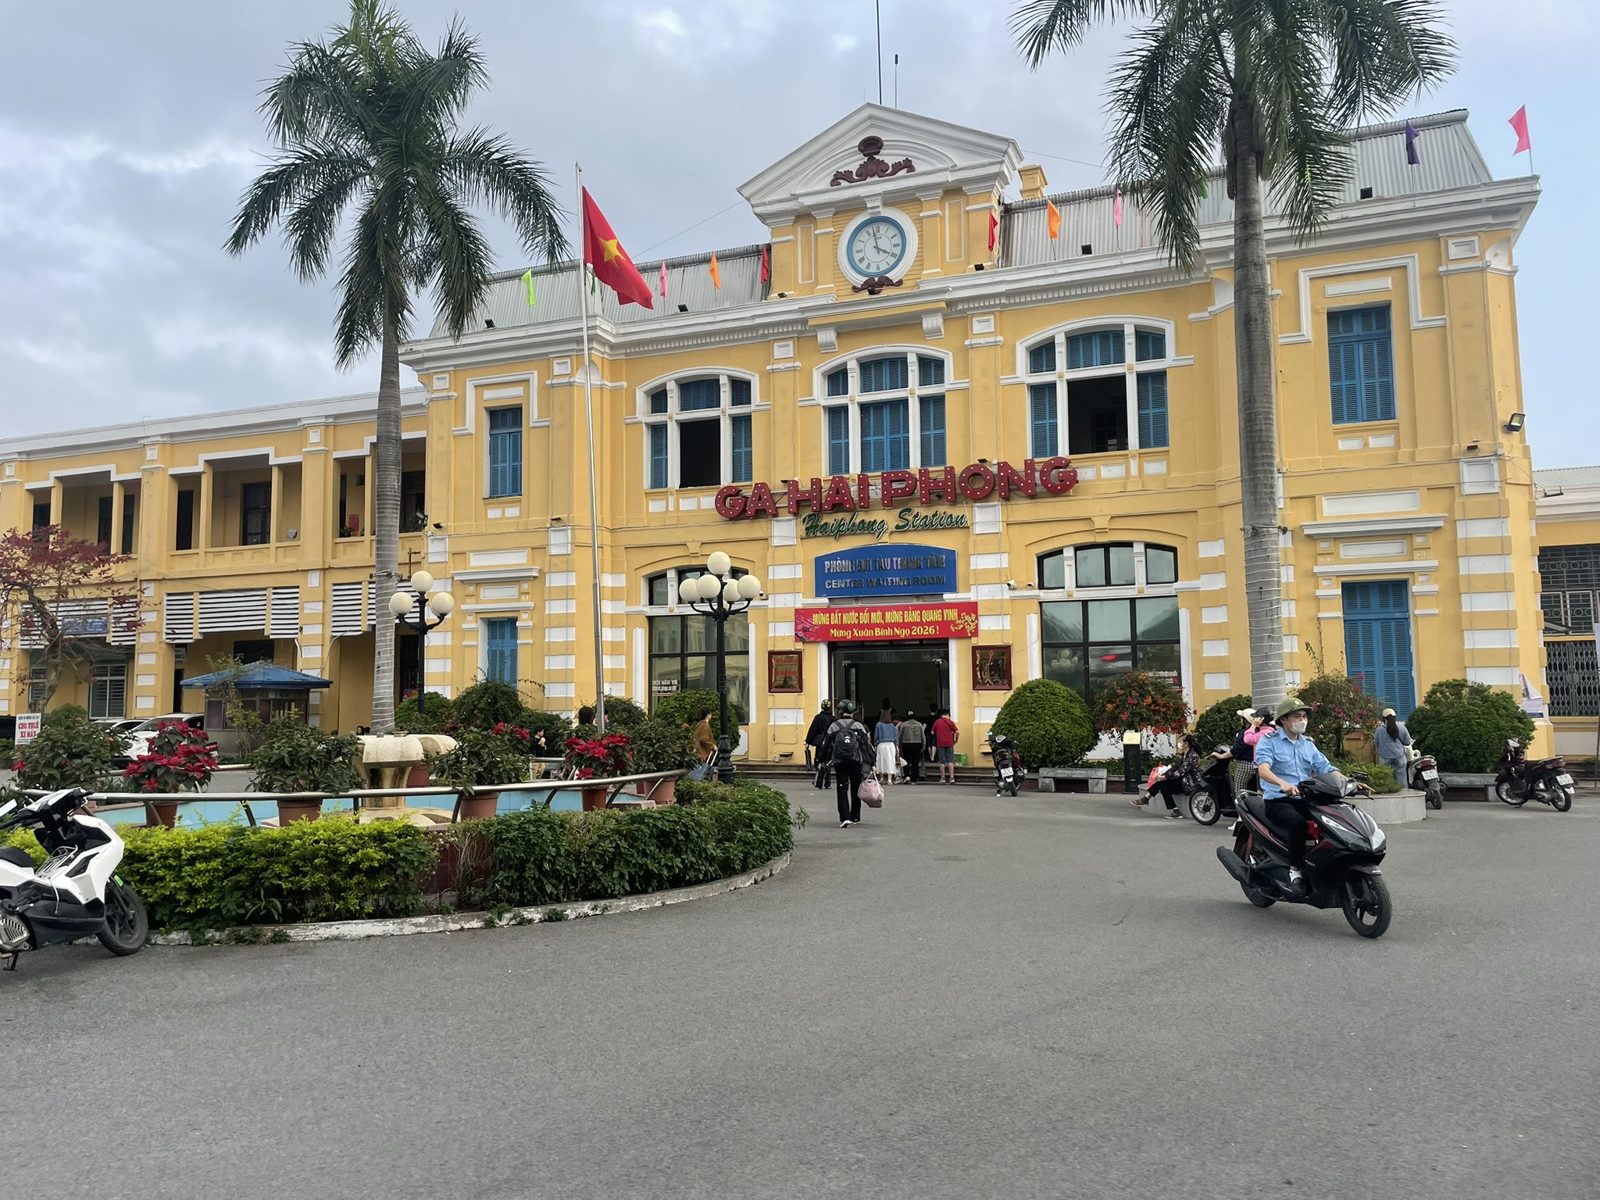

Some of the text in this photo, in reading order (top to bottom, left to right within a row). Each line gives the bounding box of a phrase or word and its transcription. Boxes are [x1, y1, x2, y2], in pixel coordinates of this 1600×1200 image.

[715, 456, 1077, 520] GA HAI PHONG
[802, 507, 968, 541] Haiphong Station
[913, 574, 946, 586] ROOM
[922, 609, 942, 623] QUANG
[943, 608, 958, 621] VINH
